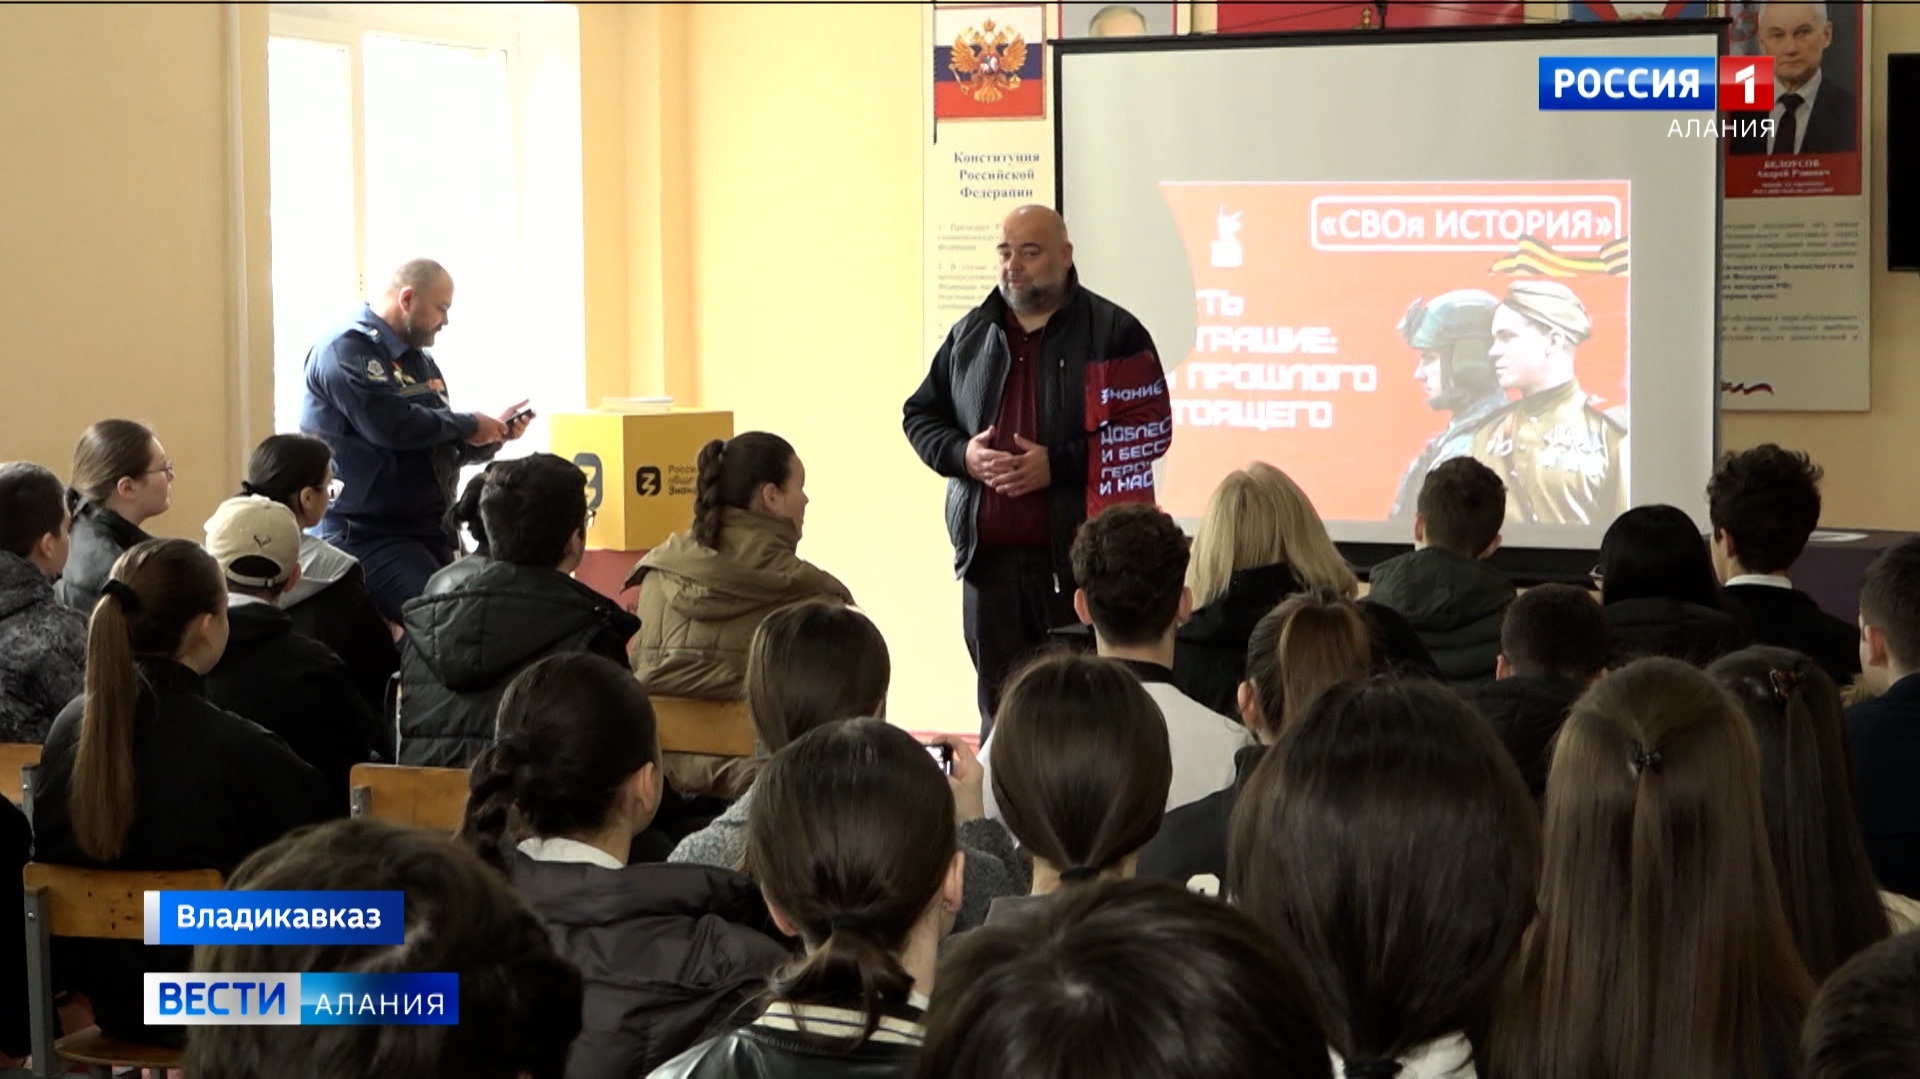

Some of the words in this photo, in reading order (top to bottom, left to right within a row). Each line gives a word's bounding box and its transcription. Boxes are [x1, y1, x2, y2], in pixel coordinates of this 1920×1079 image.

[954, 151, 1040, 166] Конституция
[959, 167, 1035, 181] Российской
[960, 186, 1033, 201] Федерации
[1435, 208, 1613, 240] ИСТОРИЯ»
[1187, 362, 1378, 392] ПРОШЛОГО
[1119, 437, 1171, 461] БЕСС
